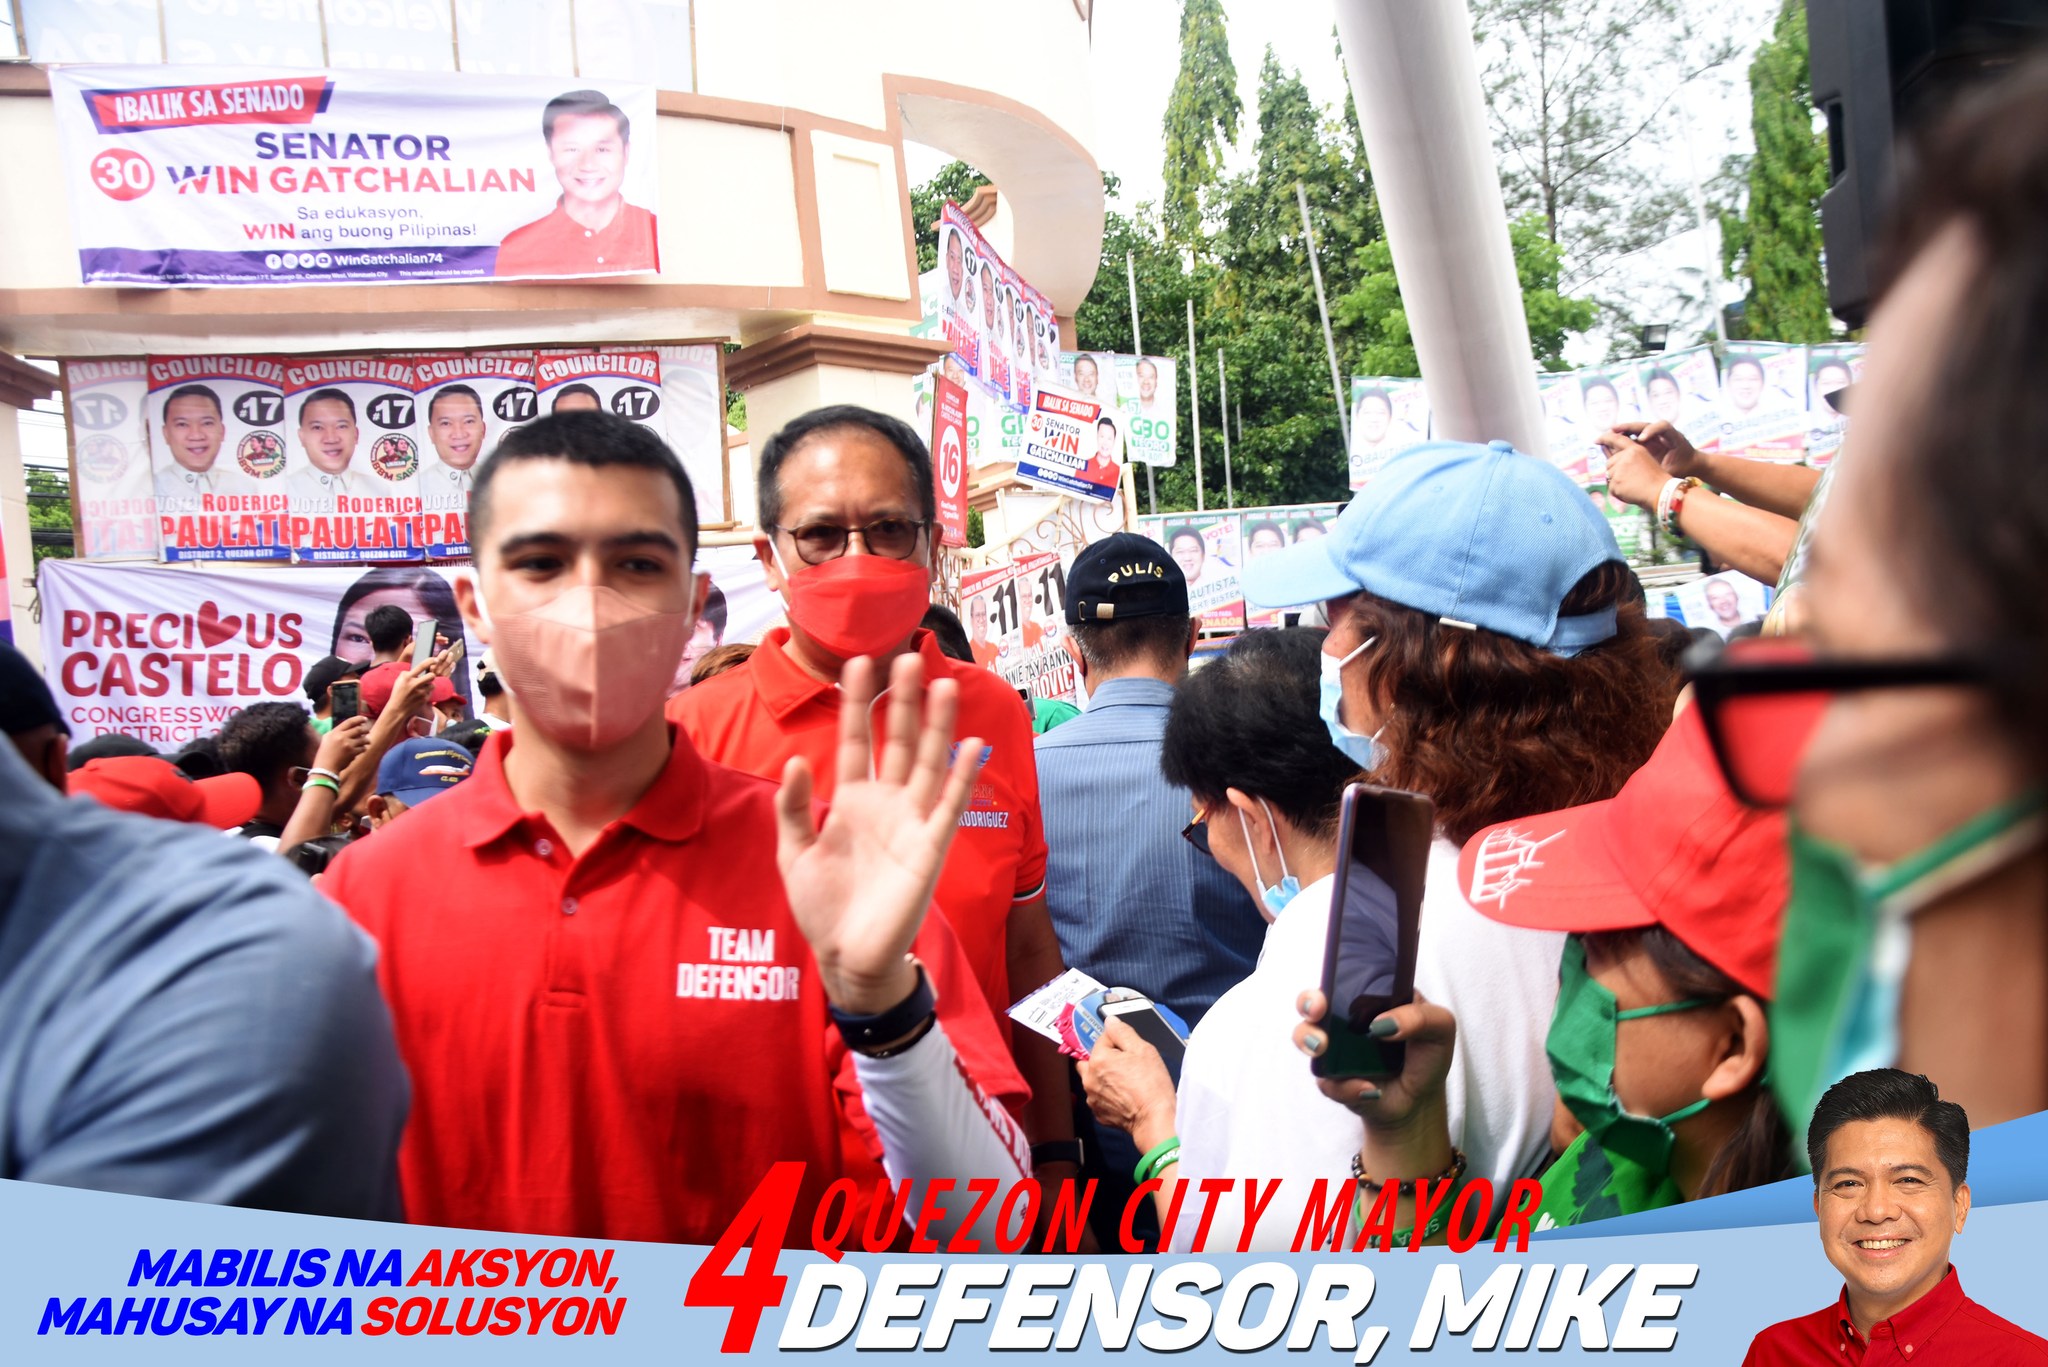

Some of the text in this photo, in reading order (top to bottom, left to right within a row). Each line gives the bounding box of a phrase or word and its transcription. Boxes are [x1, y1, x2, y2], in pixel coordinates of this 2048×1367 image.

[115, 84, 304, 123] IBALIK SA SENADO
[255, 131, 452, 161] SENATOR
[96, 156, 150, 190] 30
[166, 165, 536, 194] WIN GATCHALIAN
[297, 206, 319, 220] Sa
[242, 223, 478, 242] WIN ang buong Pilipinas!
[334, 252, 444, 267] WinGatchalian74
[537, 354, 657, 382] COUNCILOR
[616, 390, 653, 417] #17
[1045, 417, 1081, 436] SENATOR
[1044, 426, 1080, 455] WIN
[941, 440, 959, 484] 16
[1029, 444, 1087, 471] GATCHALIAN
[178, 550, 215, 560] DISTRICT
[255, 548, 274, 558] CITY
[313, 550, 349, 560] DISTRICT
[390, 550, 408, 559] CITY
[1107, 561, 1164, 583] PULIS
[1189, 576, 1240, 600] AUTISTA,
[1201, 616, 1243, 627] ENADOR
[61, 651, 303, 697] CASTELO
[71, 706, 244, 724] CONGRESSWO
[958, 810, 1009, 828] RODRIGUEZ
[707, 926, 775, 962] TEAM
[676, 963, 800, 1001] DEFENSOR
